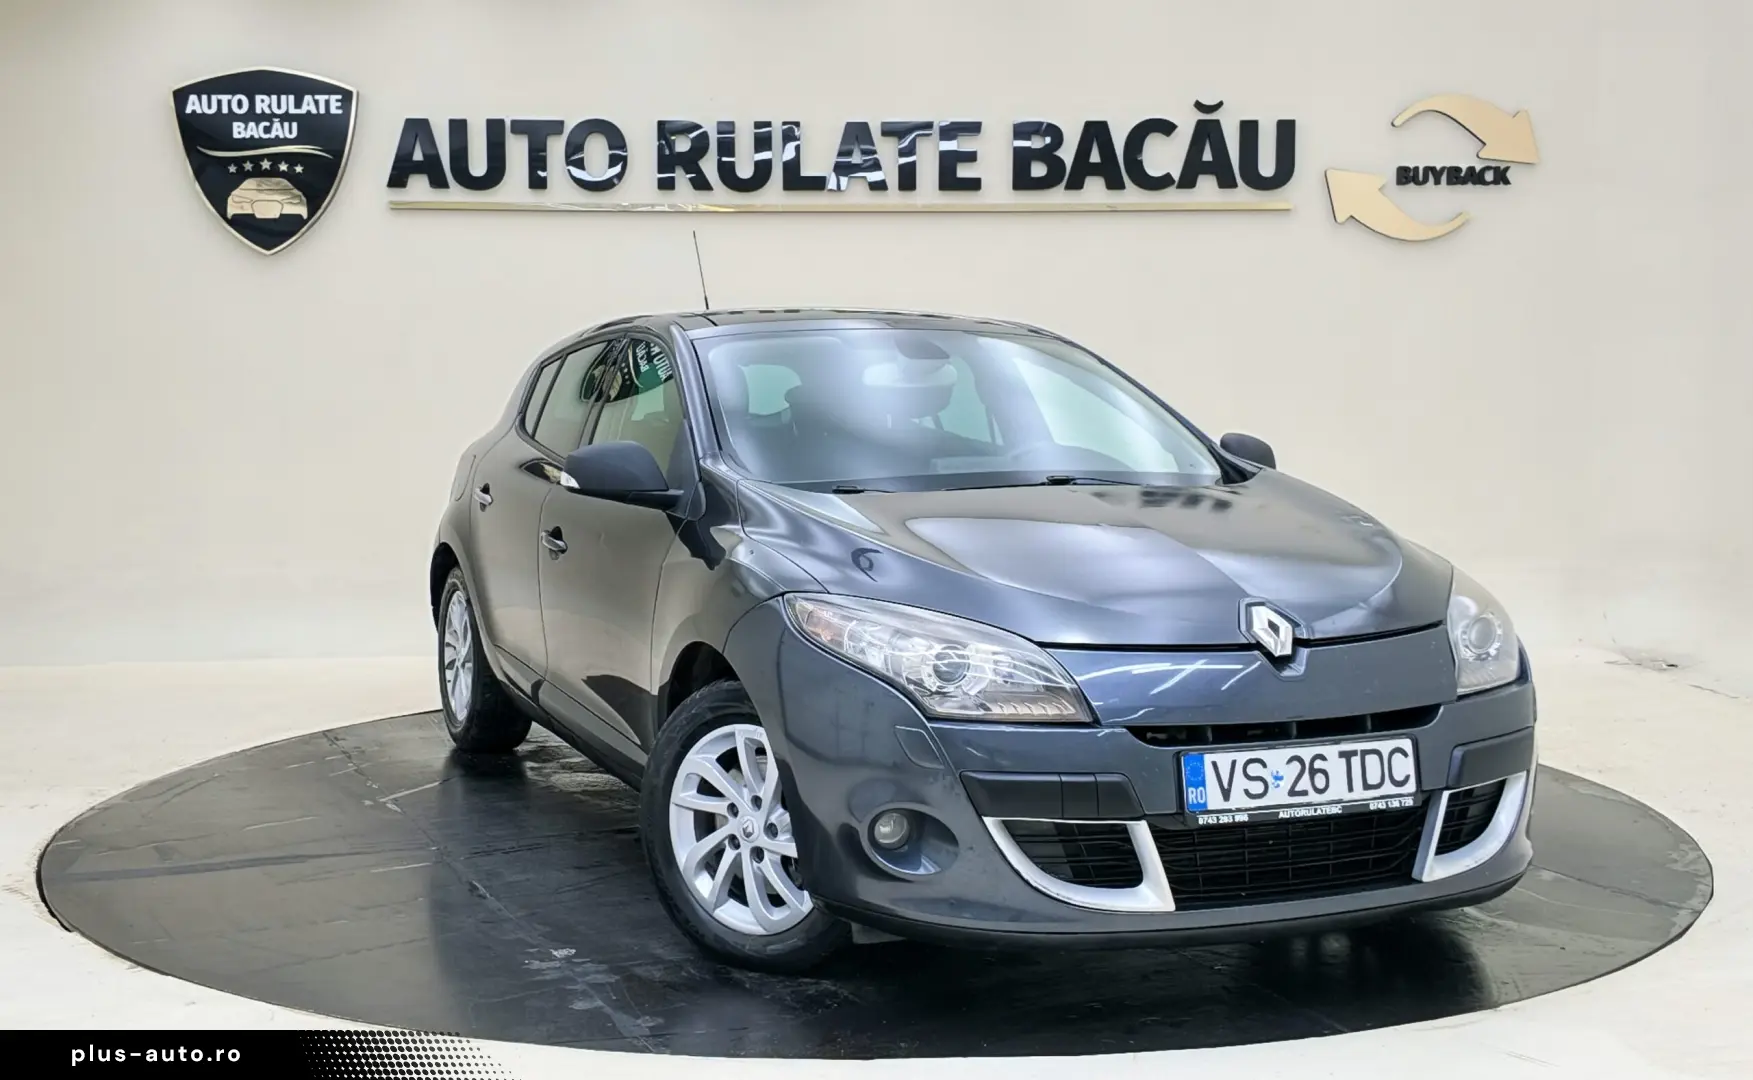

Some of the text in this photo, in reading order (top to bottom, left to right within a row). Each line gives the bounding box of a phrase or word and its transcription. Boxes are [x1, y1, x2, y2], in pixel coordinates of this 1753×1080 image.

[185, 94, 343, 115] AUTO RULATE
[232, 118, 298, 139] BACĂU
[386, 99, 1296, 192] AUTO RULATE BACĂU
[1396, 165, 1512, 186] BUYBACK
[1211, 746, 1411, 803] VS 26 TDC
[1188, 787, 1207, 804] RO
